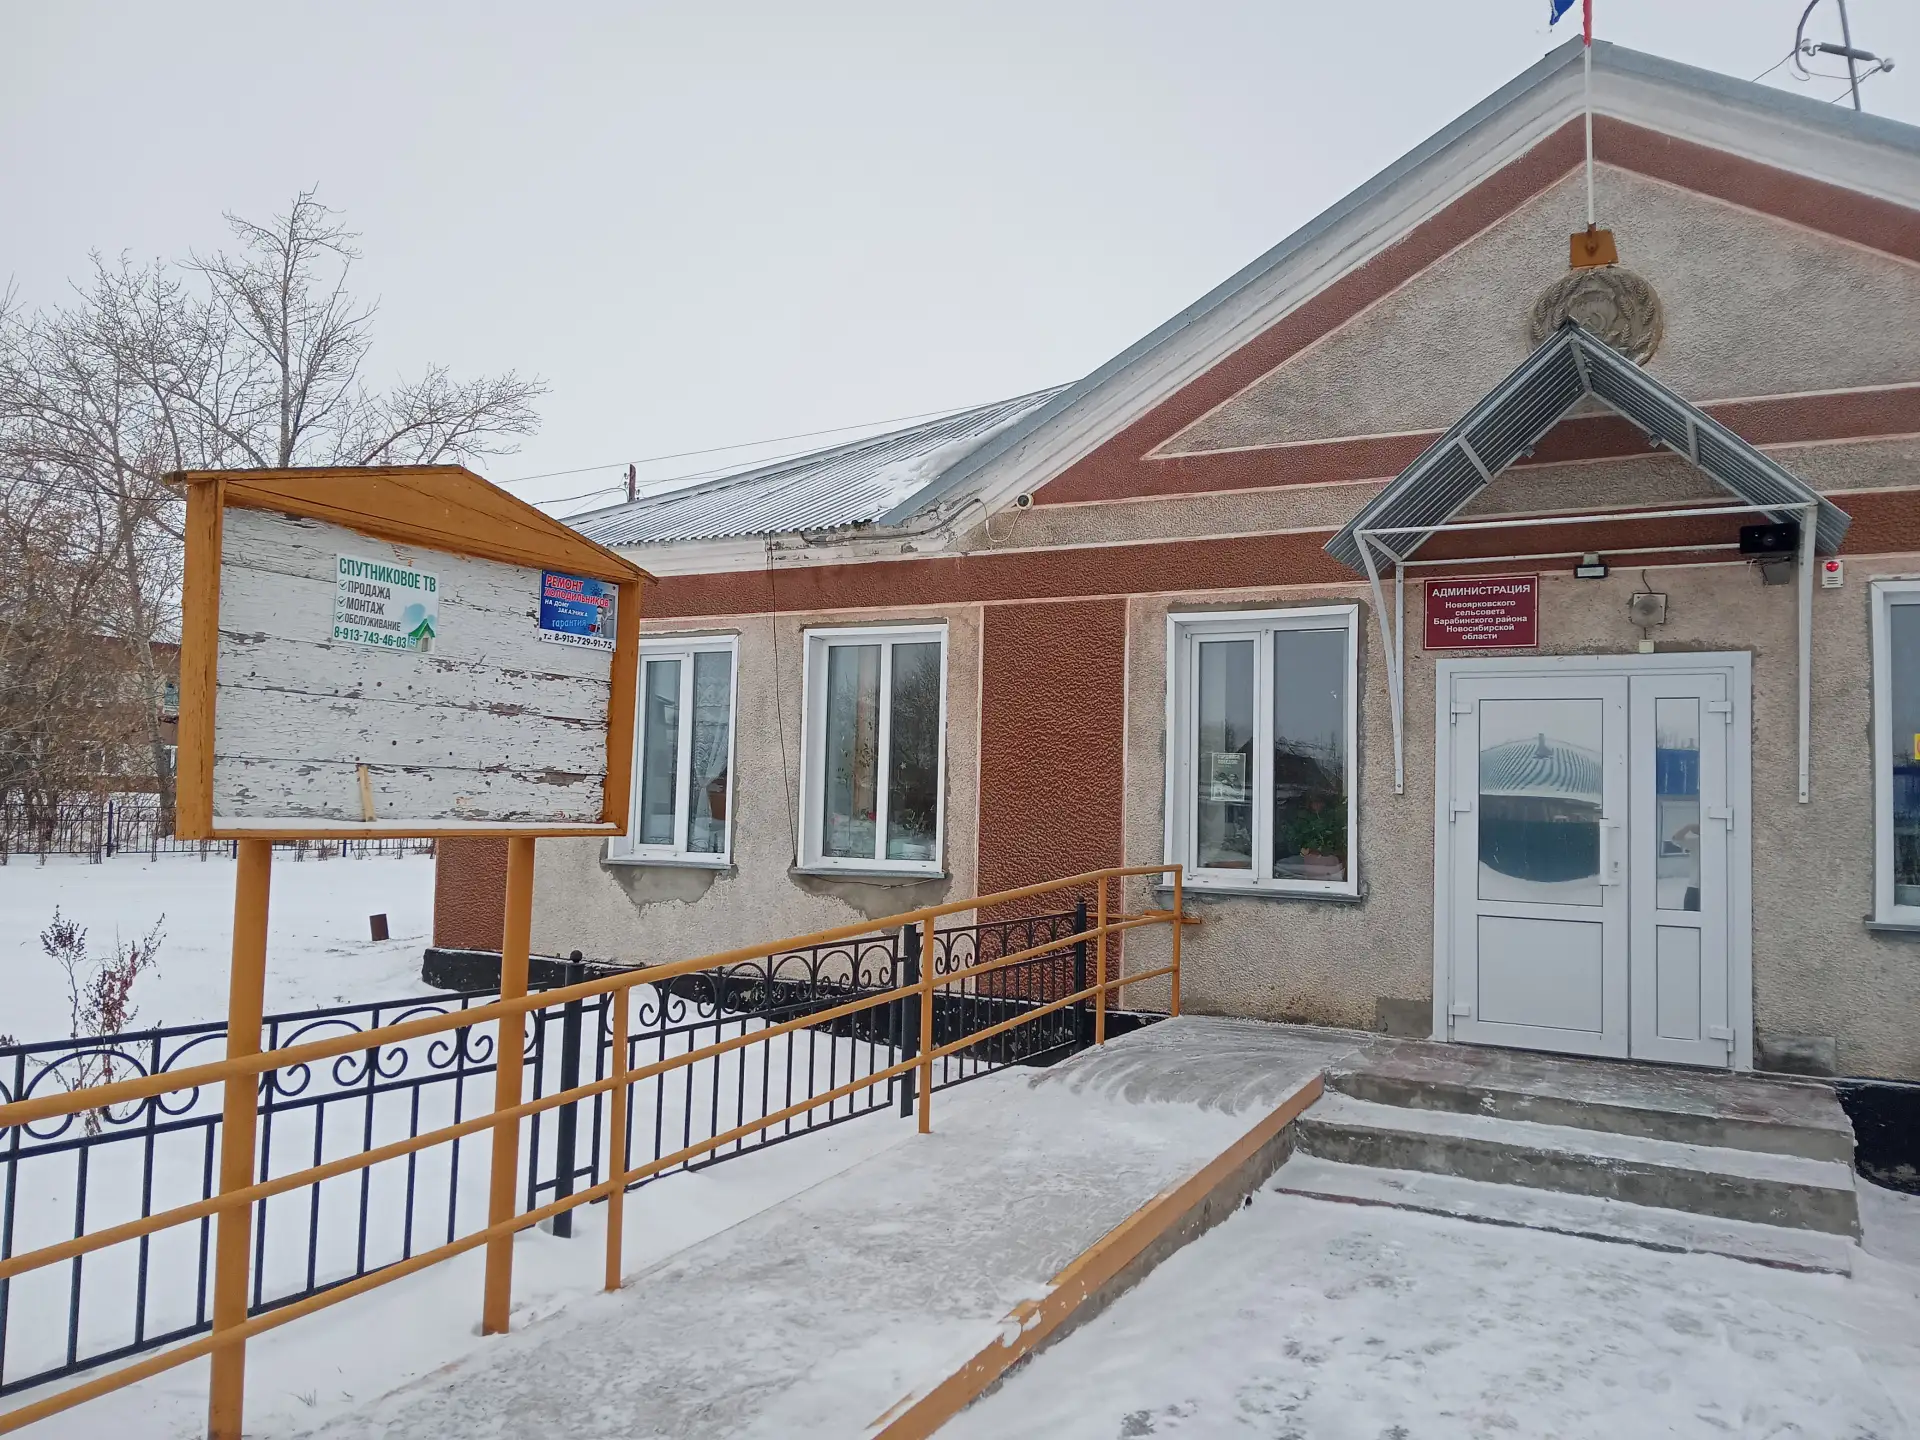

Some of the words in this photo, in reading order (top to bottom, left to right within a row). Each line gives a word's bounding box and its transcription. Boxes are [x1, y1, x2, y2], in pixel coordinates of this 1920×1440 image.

[340, 558, 420, 589] СПУТНИКОВОЕ
[423, 575, 436, 592] ТВ
[546, 574, 584, 591] РЕМОНТ
[348, 581, 391, 600] ПРОДАЖА
[544, 587, 610, 608] ХОЛОДИЛЬНИКОВ
[1432, 584, 1530, 597] АДМИНИСТРАЦИЯ
[346, 597, 385, 615] МОНТАЖ
[554, 600, 569, 608] ДОМУ
[1445, 599, 1516, 608] Новоярковского
[558, 607, 588, 617] ЗАКАЗЧИКА
[1455, 608, 1505, 616] сельсовета
[345, 613, 401, 631] ОБСЛУЖИВАНИЕ
[552, 619, 587, 629] гарантия
[1434, 617, 1493, 626] Барабинского
[1496, 615, 1528, 624] района
[1446, 624, 1514, 632] Новосибирской
[334, 626, 407, 648] 8-913-743-46-03
[554, 633, 612, 649] 8-913-729-91-75
